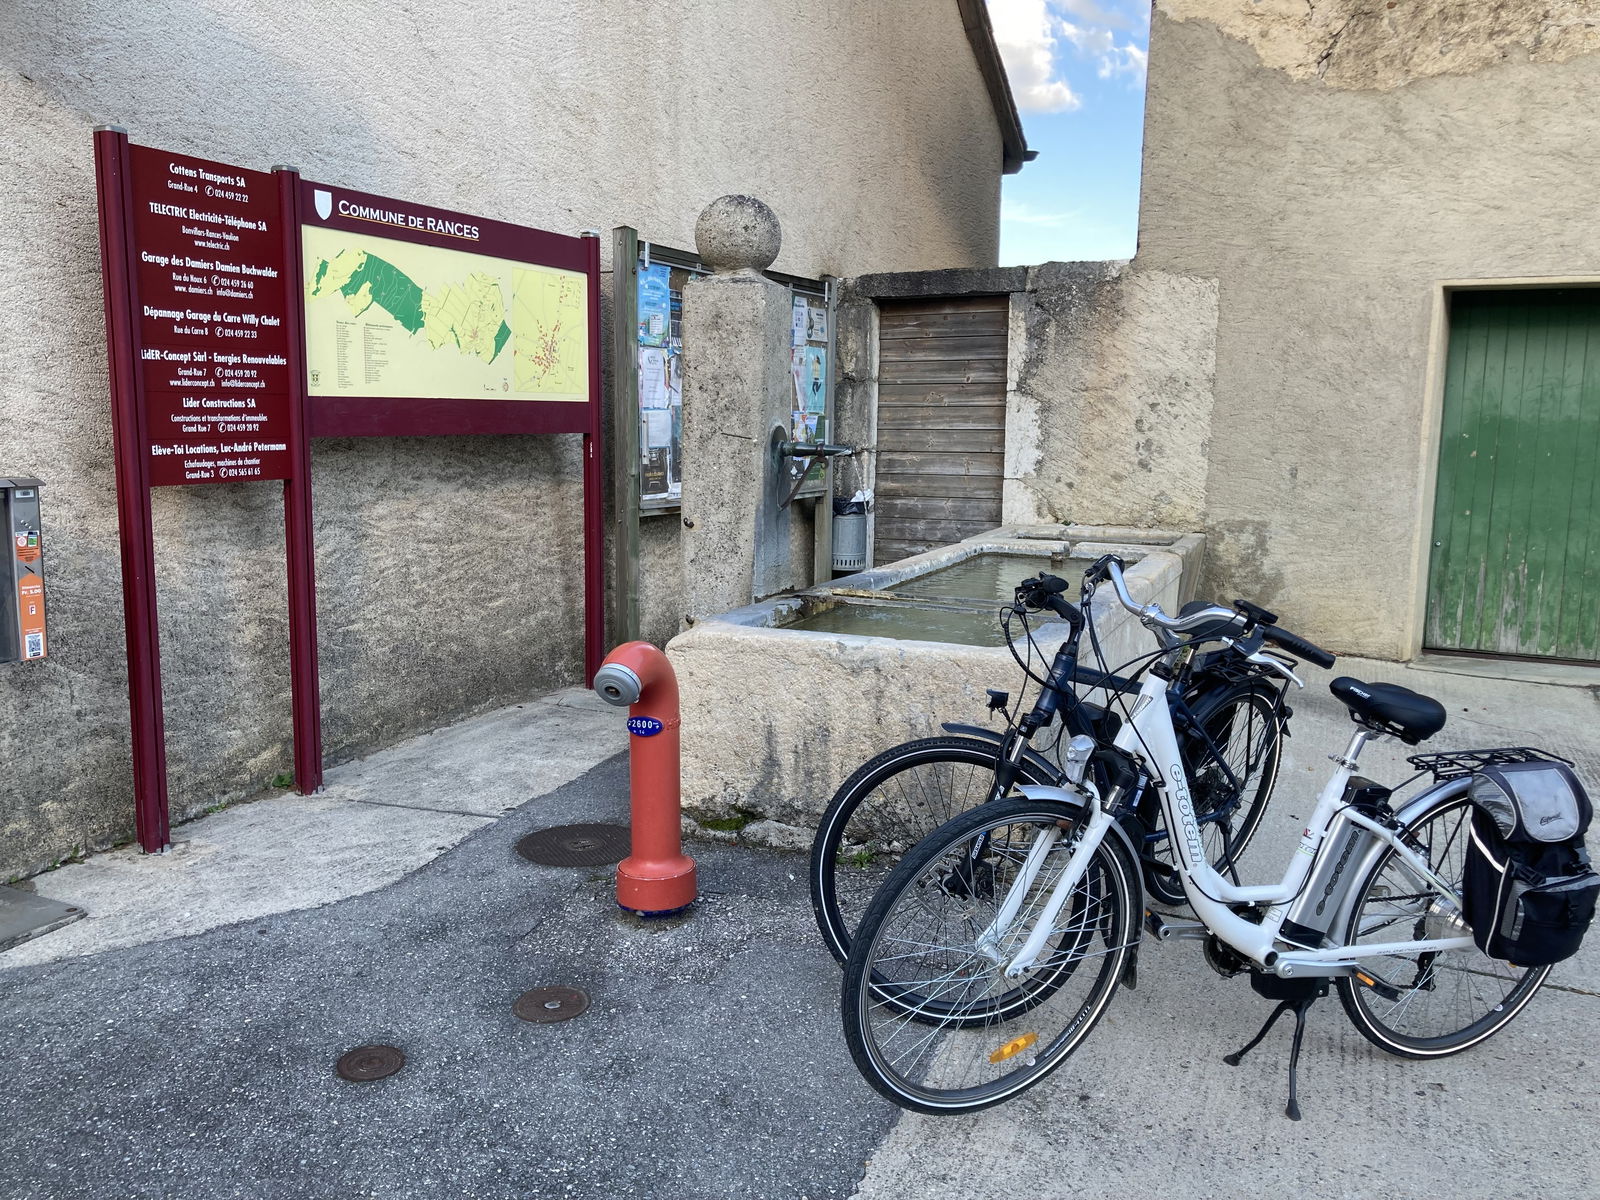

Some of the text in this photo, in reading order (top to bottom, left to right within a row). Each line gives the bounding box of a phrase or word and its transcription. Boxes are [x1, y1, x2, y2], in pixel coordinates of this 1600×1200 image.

[170, 163, 246, 187] Cottens Transports SA
[168, 180, 248, 203] Grand-Rue 4 024 459 22 22
[149, 202, 267, 231] TELECTRIC Electricité-Téléphone SA
[338, 200, 480, 239] COMMUNE DE RANCES
[194, 240, 230, 250] www.telectric.ch
[142, 251, 278, 278] Garage des Damiers Damien Buchwalder
[172, 272, 182, 282] Rue
[221, 278, 230, 286] 024
[231, 279, 239, 287] 459
[188, 285, 213, 295] damiers.ch
[217, 288, 253, 299] info@damiers.ch
[144, 306, 280, 327] Dépannage Garage du Carre Willy Chalet
[174, 326, 184, 334] Rue
[184, 326, 190, 334] du
[191, 327, 204, 335] Carre
[224, 328, 234, 337] 024
[235, 329, 243, 337] 459
[251, 330, 257, 338] 33
[141, 349, 191, 363] LidER-Concept
[193, 351, 207, 362] Sàrl
[214, 353, 241, 365] Energies
[243, 354, 287, 365] Renouvelables
[178, 368, 202, 376] Grand-Rue
[169, 379, 265, 388] www.liderconcept.ch info@liderconcept.ch
[183, 398, 256, 408] Lider Constructions SA
[152, 442, 286, 455] Elève-Toi Locations, Luc-André Petermann
[184, 460, 216, 469] Echafaudages,
[186, 470, 210, 479] Grand-Rue
[228, 469, 238, 477] 024
[632, 719, 653, 728] 2600
[1170, 763, 1204, 863] e-totem
[1315, 829, 1361, 916] e-totem
